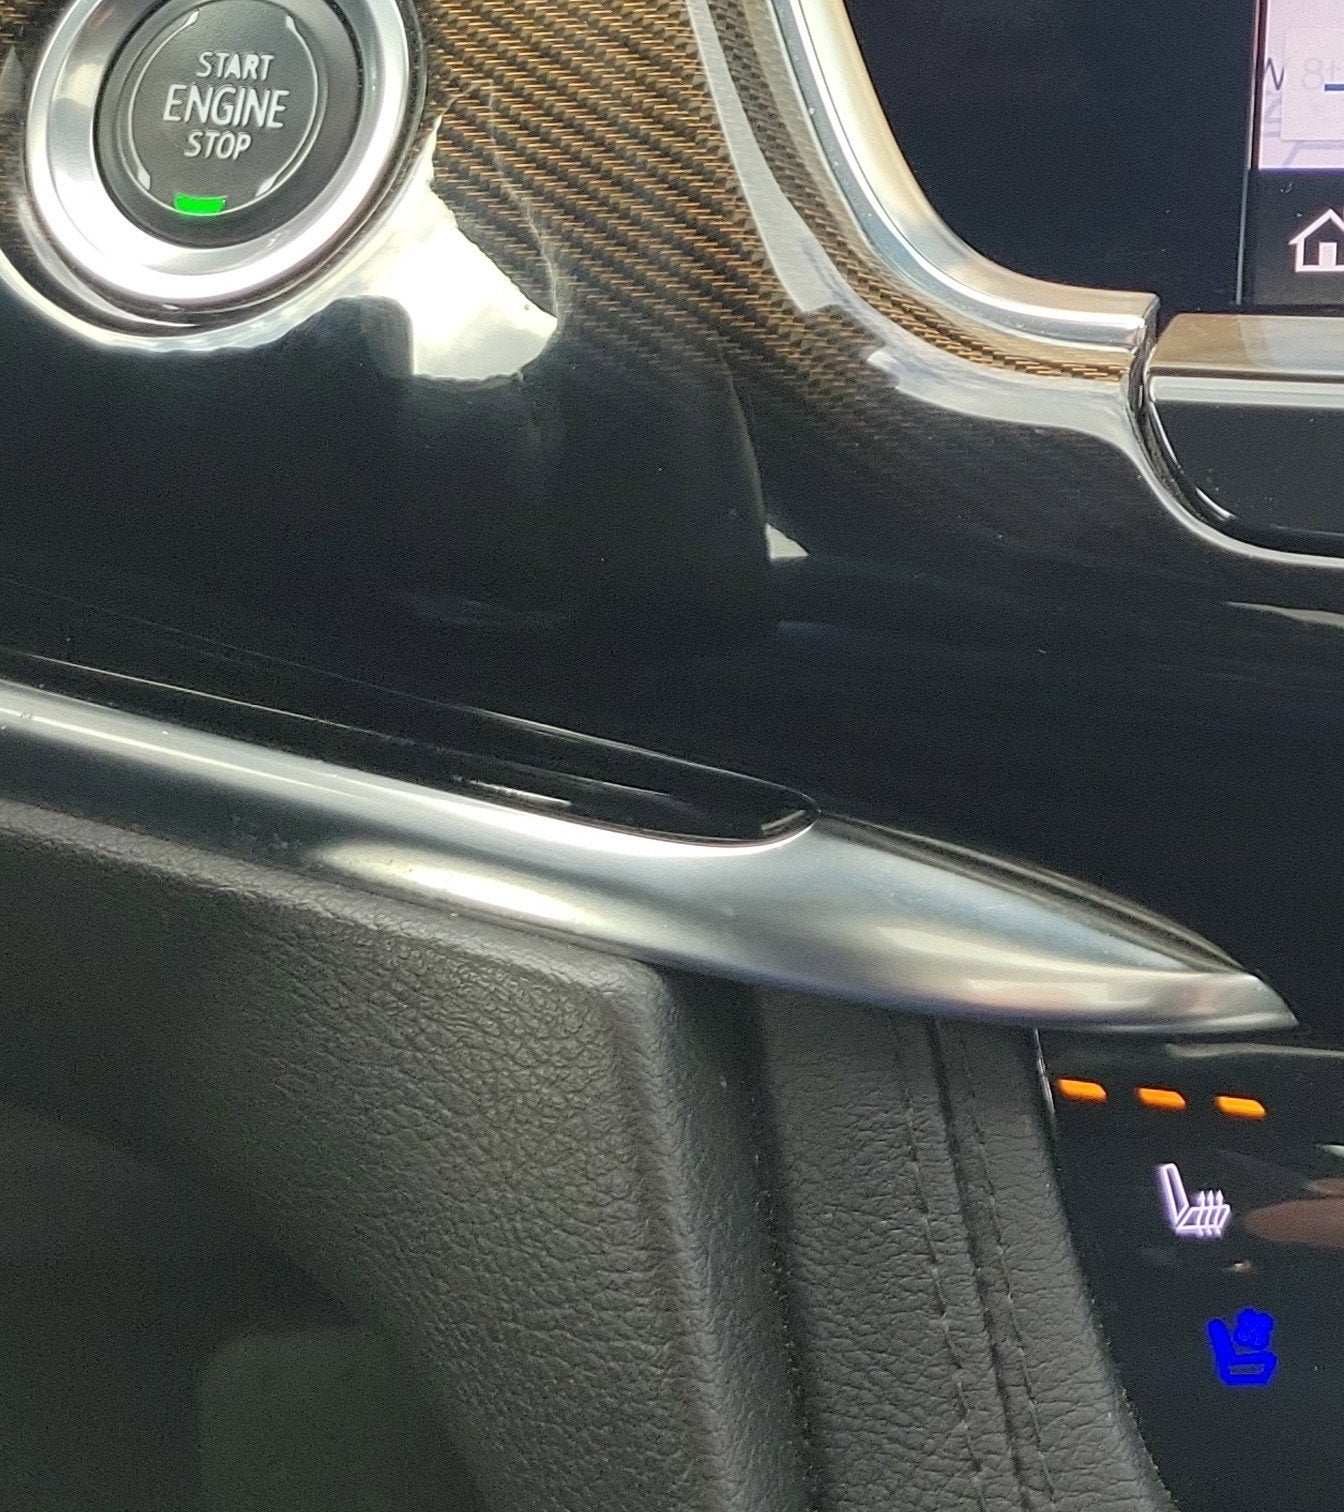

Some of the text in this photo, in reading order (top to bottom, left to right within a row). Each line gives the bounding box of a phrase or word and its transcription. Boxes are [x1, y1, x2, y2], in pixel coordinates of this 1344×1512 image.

[195, 50, 276, 81] START
[162, 83, 291, 129] ENGINE
[183, 130, 252, 160] STOP
